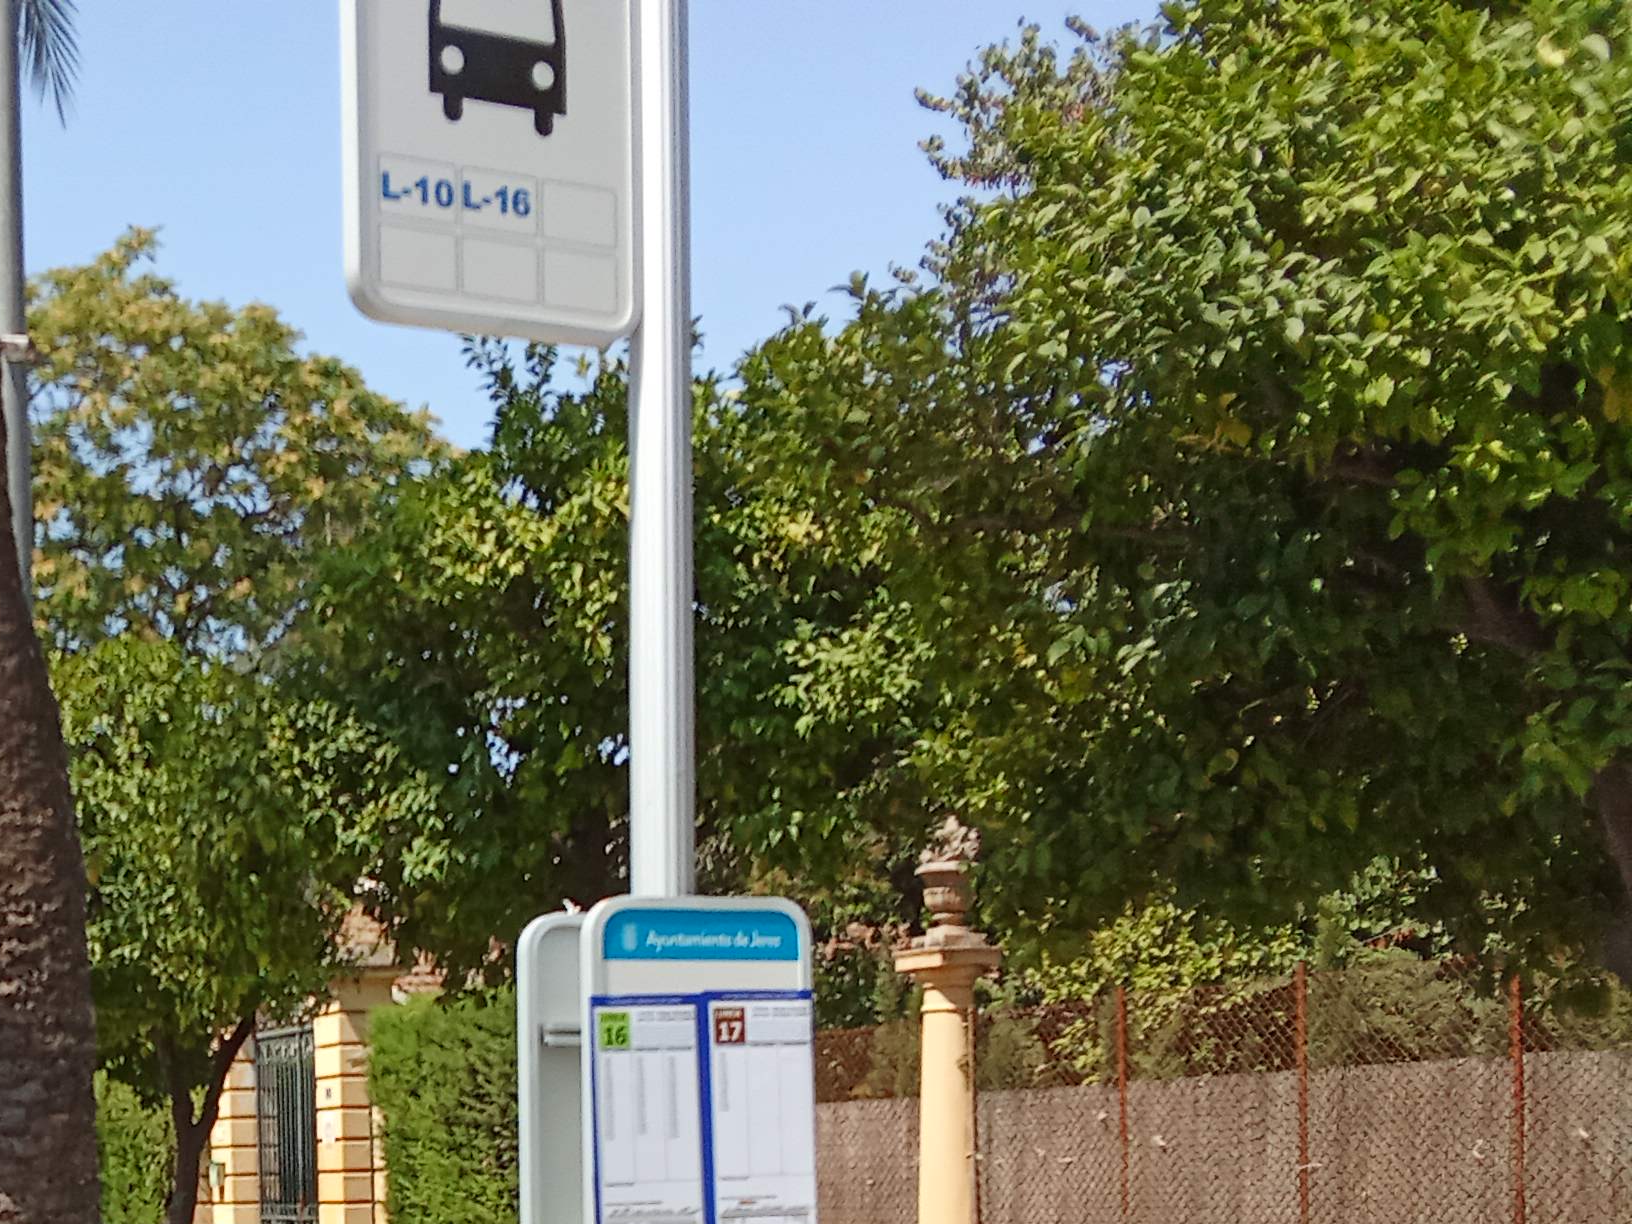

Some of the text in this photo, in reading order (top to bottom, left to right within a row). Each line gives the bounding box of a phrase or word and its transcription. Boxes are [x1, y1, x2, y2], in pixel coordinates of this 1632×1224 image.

[381, 170, 531, 217] L-10 L-16
[603, 1025, 626, 1046] 16
[718, 1022, 742, 1042] 17
